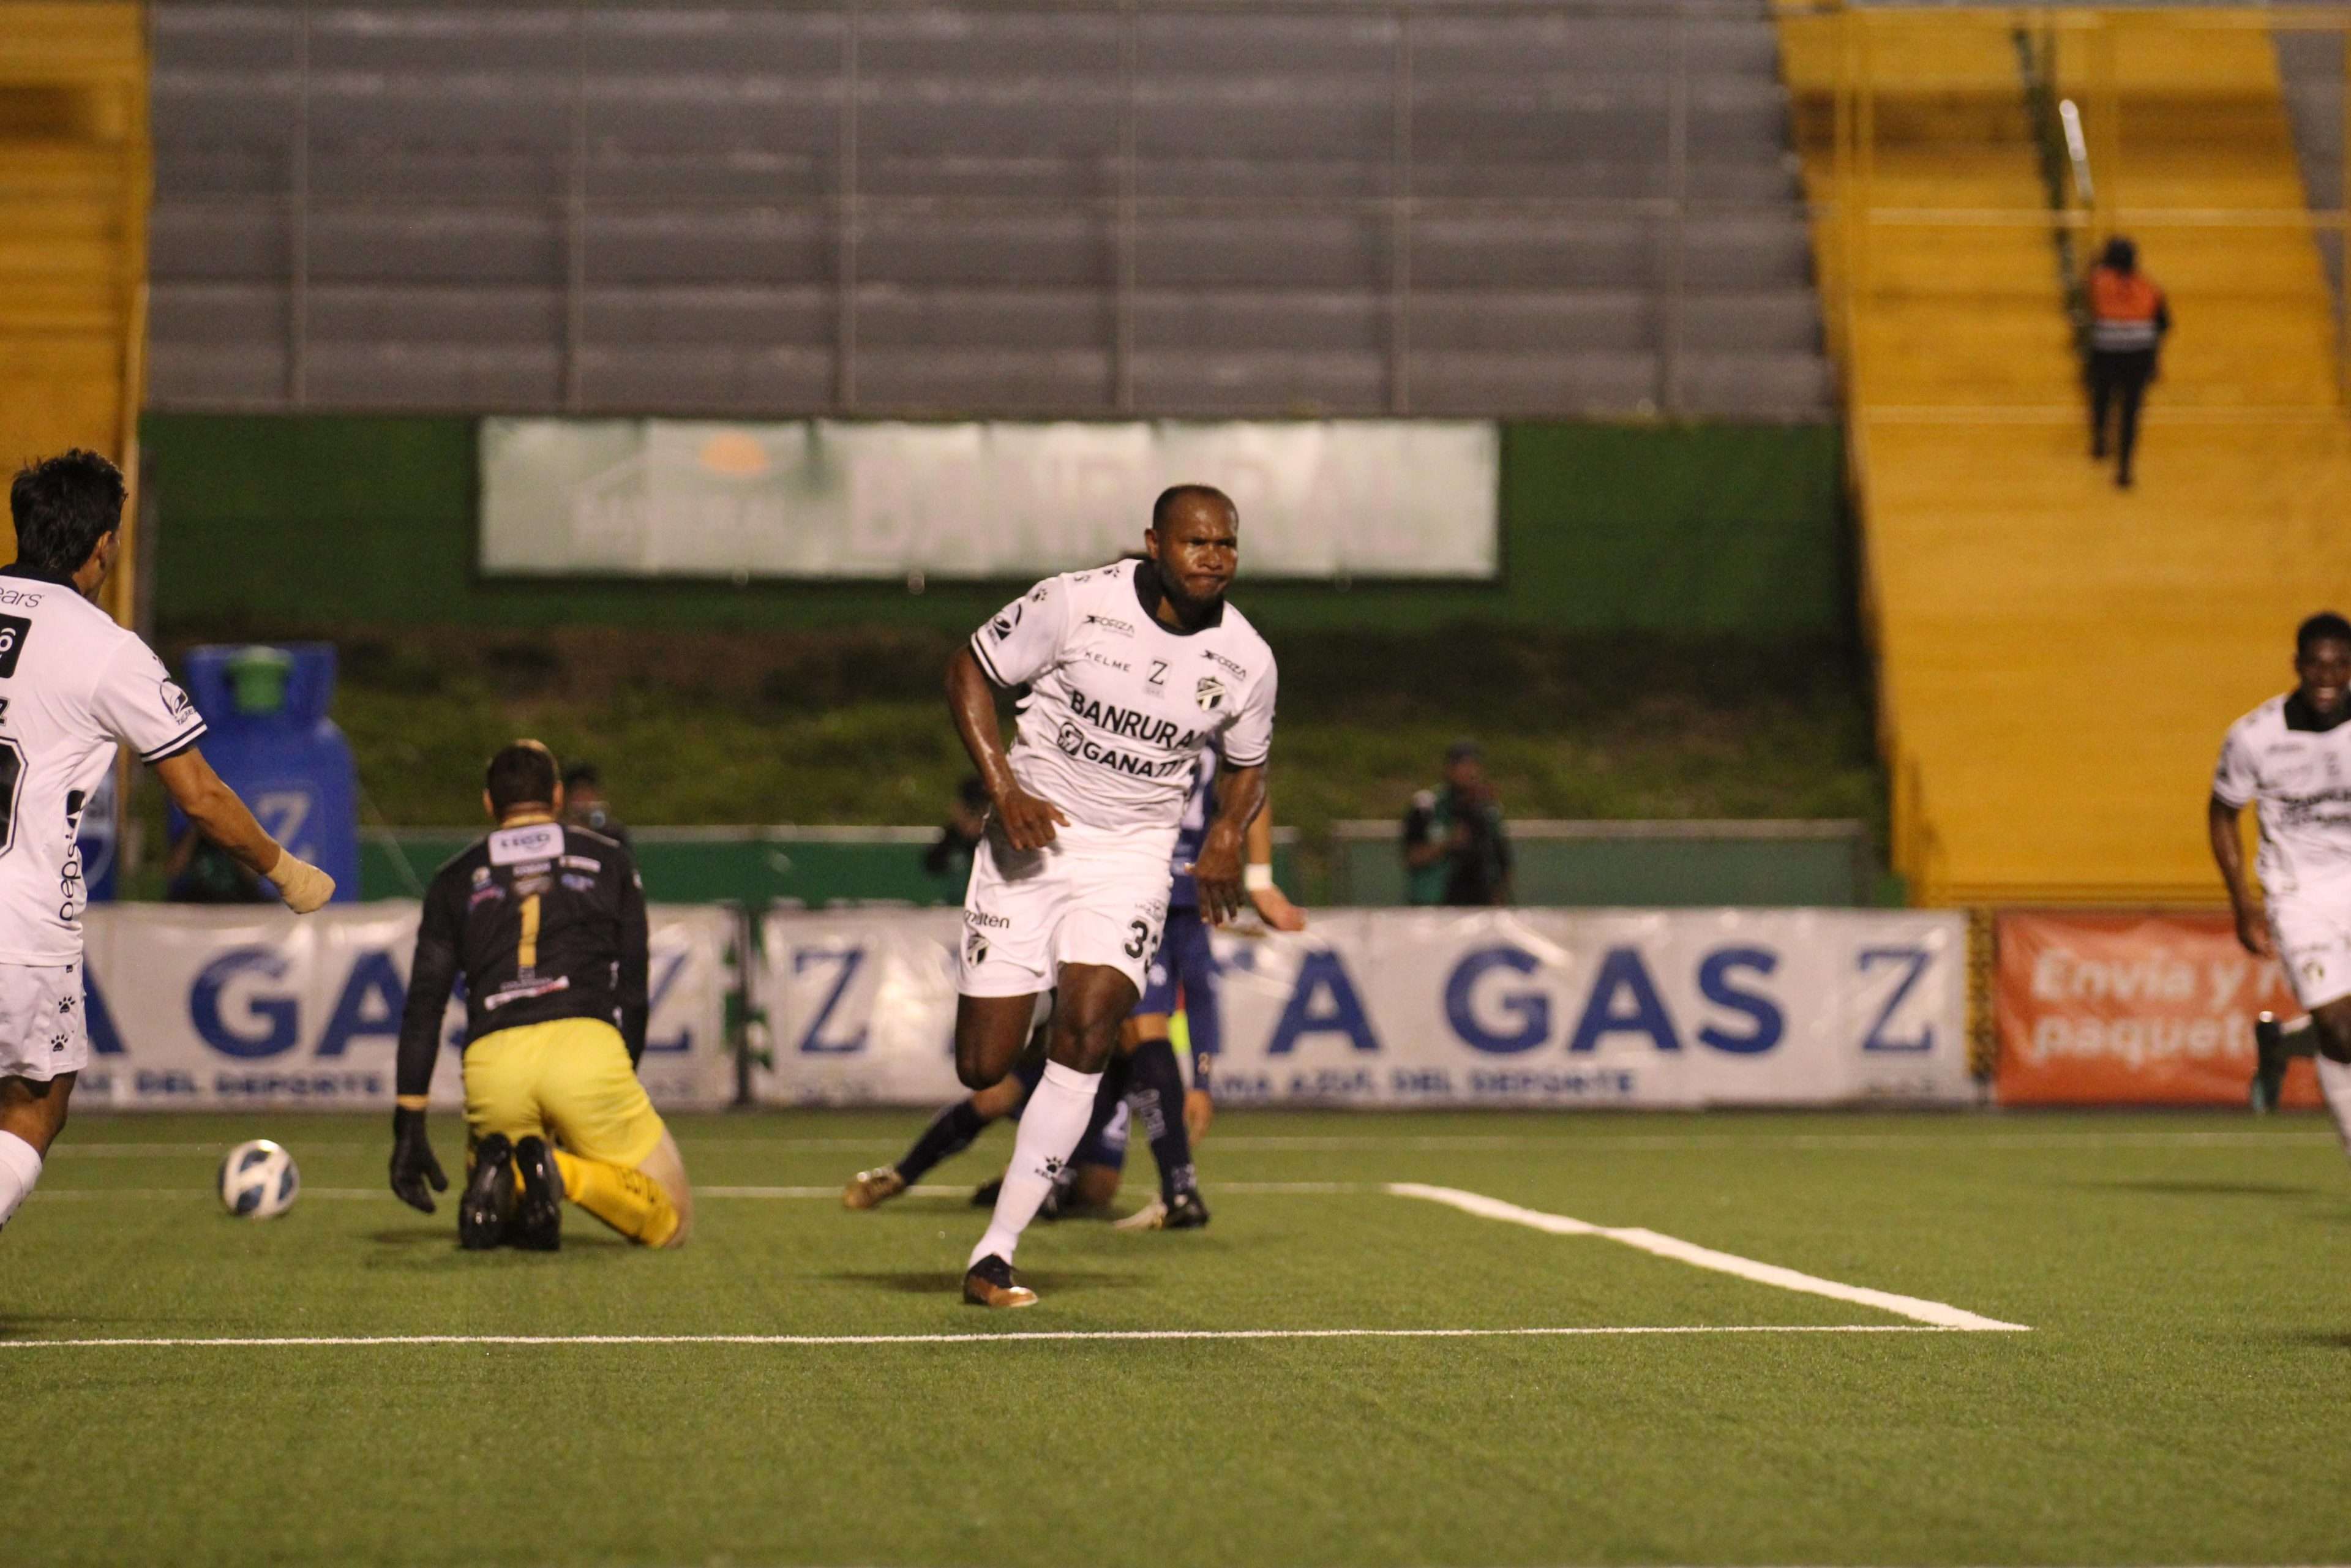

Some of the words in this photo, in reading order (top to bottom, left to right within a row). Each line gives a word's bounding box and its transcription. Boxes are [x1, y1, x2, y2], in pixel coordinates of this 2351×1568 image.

[850, 457, 1419, 554] BANRRAL
[1084, 651, 1132, 673] KELME
[1071, 689, 1204, 750] BANRURA
[518, 893, 541, 967] 1
[795, 947, 868, 1053] Z
[1445, 946, 1785, 1054] GAS
[1859, 947, 1933, 1052] Z
